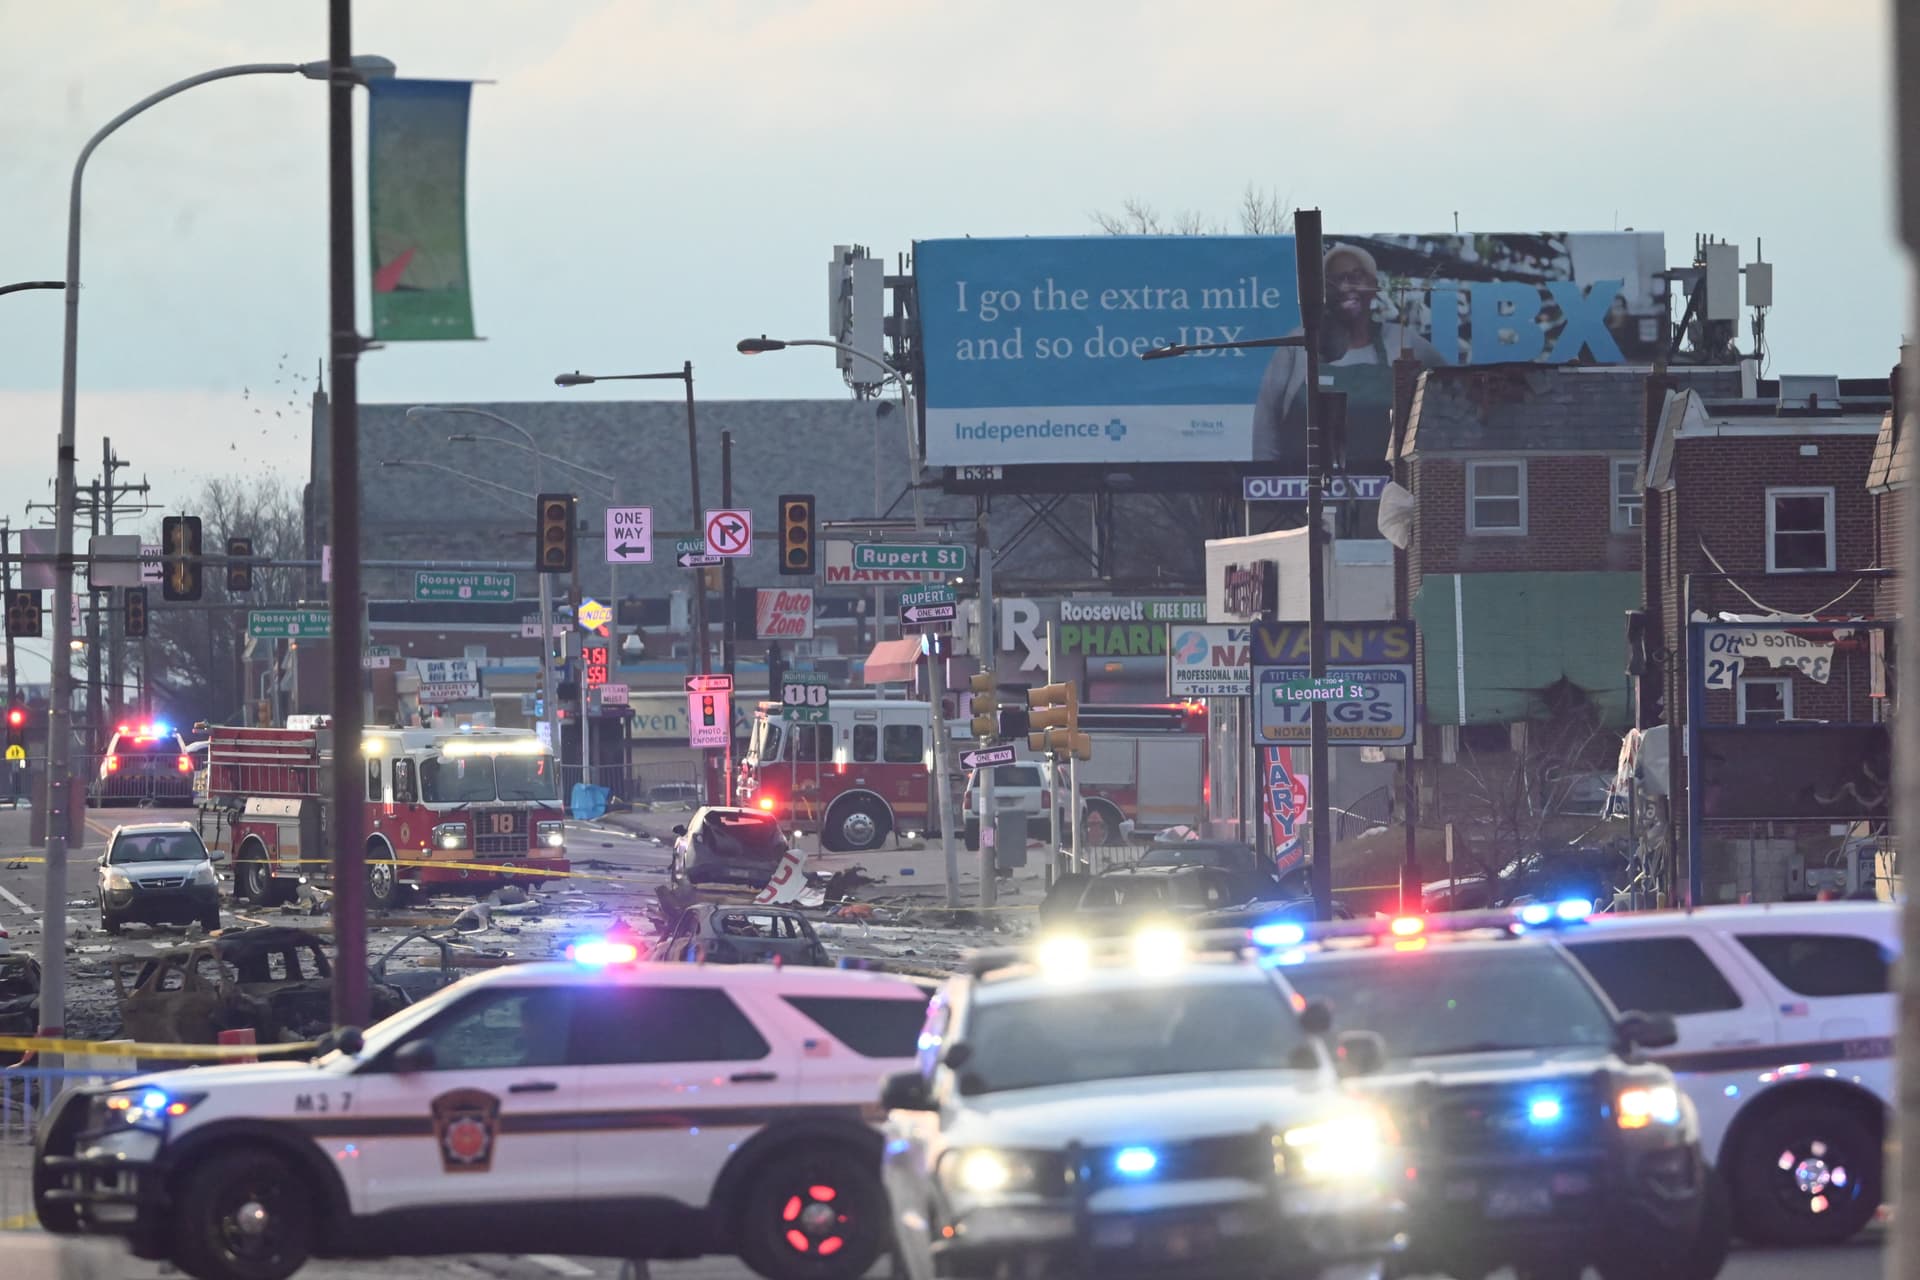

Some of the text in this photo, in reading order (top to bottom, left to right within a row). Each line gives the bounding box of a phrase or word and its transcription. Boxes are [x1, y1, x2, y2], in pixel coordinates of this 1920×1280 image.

[957, 276, 1281, 322] I go the extra mile
[1430, 280, 1626, 364] IBX
[956, 326, 1247, 360] and so does IBX
[955, 421, 1099, 442] Independence
[1249, 479, 1381, 497] OUTFONT
[614, 512, 644, 525] ONE
[614, 527, 644, 540] WAY
[863, 549, 957, 566] Rupert St
[420, 575, 511, 586] Roosevelt Blvd
[774, 590, 811, 613] Auto
[902, 590, 945, 605] RUPERT
[253, 614, 306, 623] Roosevelt
[917, 607, 951, 617] ONE WAY
[1060, 601, 1143, 622] Roosevelt
[1153, 603, 1180, 619] FREE
[765, 612, 806, 635] Zone
[1060, 624, 1177, 657] PHARM
[1177, 670, 1231, 680] PROFESSIONAL
[1270, 671, 1397, 681] TITLES EGISTRATION
[791, 688, 820, 702] 1 1
[1191, 685, 1214, 693] Tel:
[1287, 686, 1344, 700] Leonard
[1350, 685, 1364, 697] St
[994, 752, 1010, 760] WAY
[491, 814, 514, 833] 18
